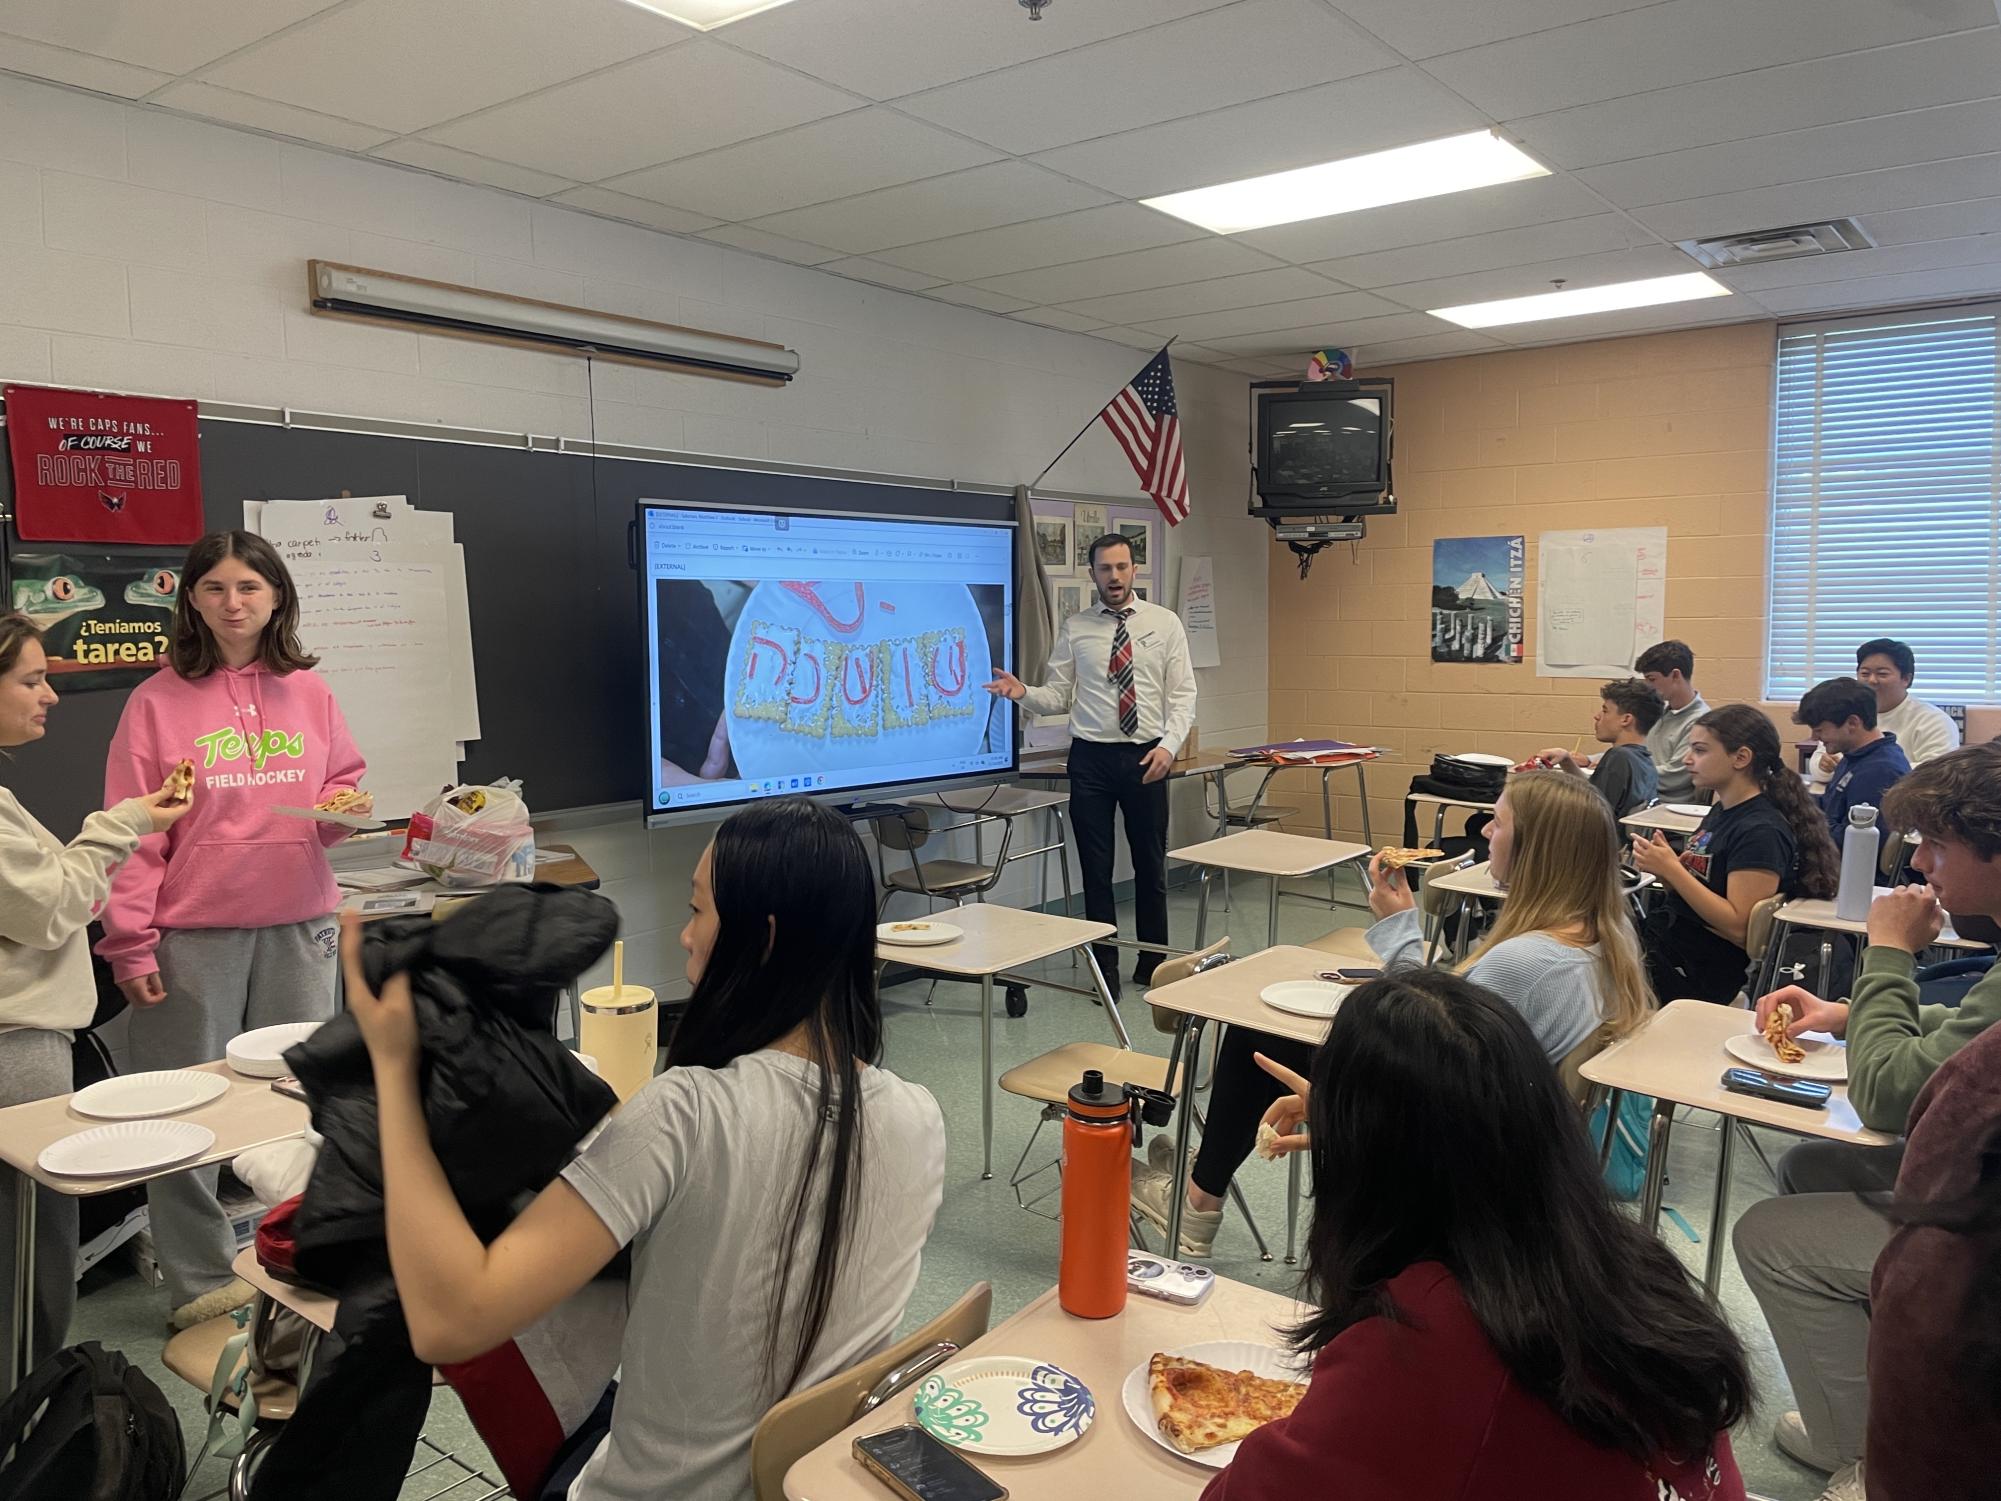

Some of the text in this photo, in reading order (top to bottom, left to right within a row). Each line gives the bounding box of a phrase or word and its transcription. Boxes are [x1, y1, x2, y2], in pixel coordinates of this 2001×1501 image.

[48, 417, 164, 436] WE'RE CAPS FANS...
[58, 435, 152, 452] OF COURSE WE
[37, 454, 181, 489] ROCK THE RED
[1507, 537, 1523, 572] ITZÁ
[80, 619, 161, 636] ¿Teníamos
[73, 635, 169, 664] tarea?
[195, 727, 304, 769] Terps
[205, 769, 306, 790] FIELD HOCKEY
